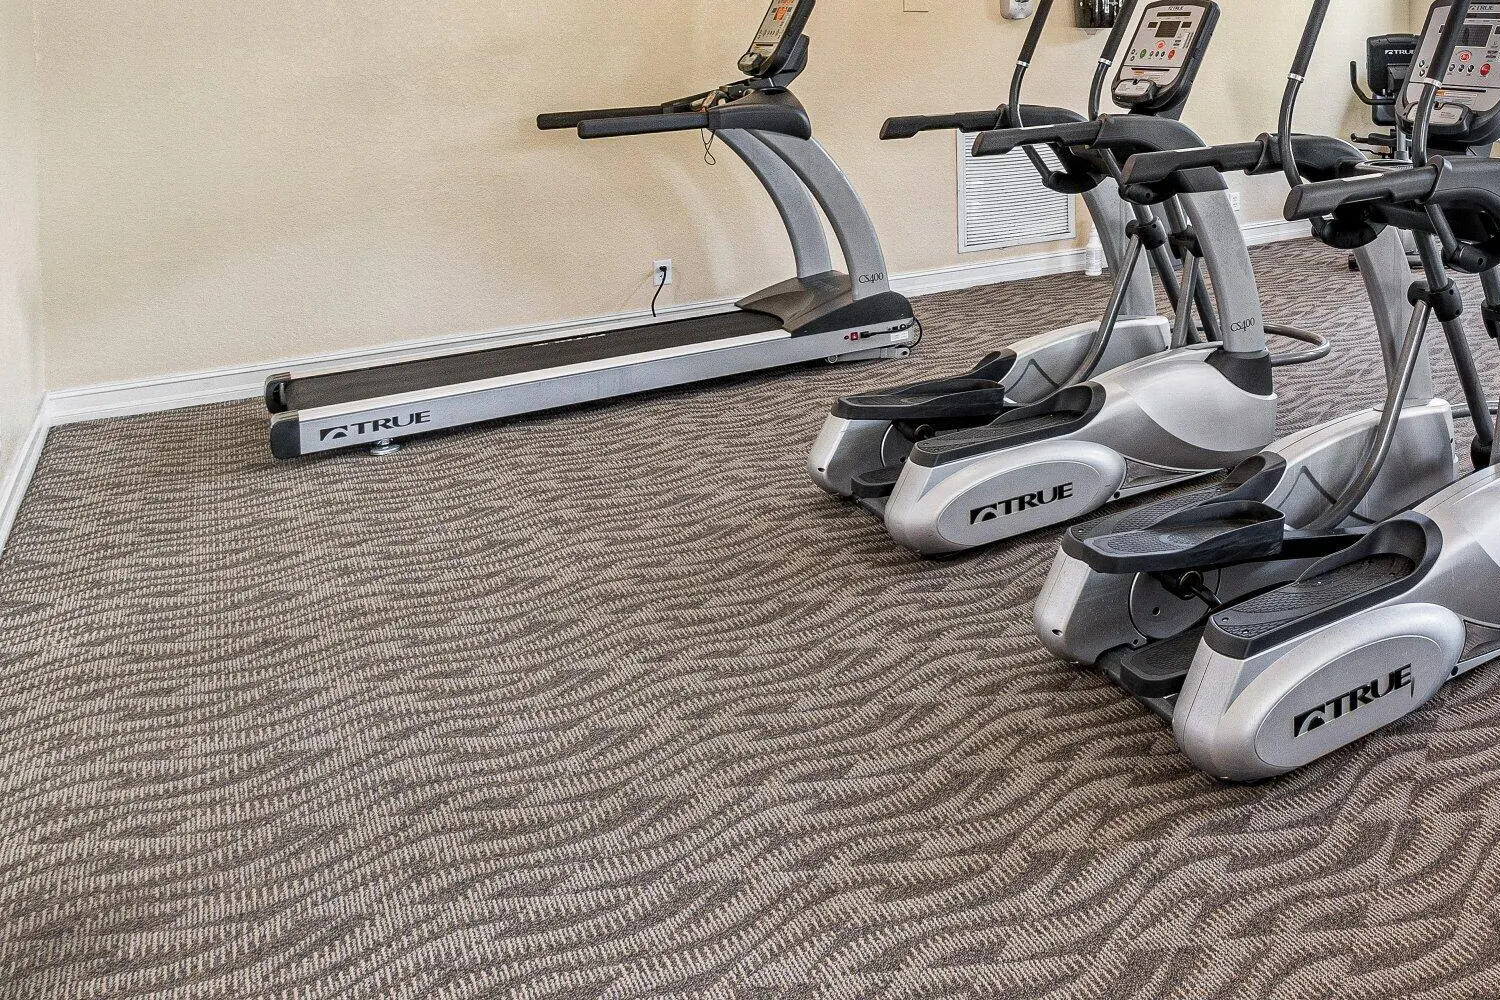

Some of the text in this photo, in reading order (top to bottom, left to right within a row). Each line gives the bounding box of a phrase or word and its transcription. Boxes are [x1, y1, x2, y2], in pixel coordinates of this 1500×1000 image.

[858, 273, 884, 284] CS400
[1230, 317, 1255, 331] CS400
[350, 410, 431, 434] TRUE
[998, 482, 1073, 515] TRUE
[1325, 663, 1412, 719] TRUE
